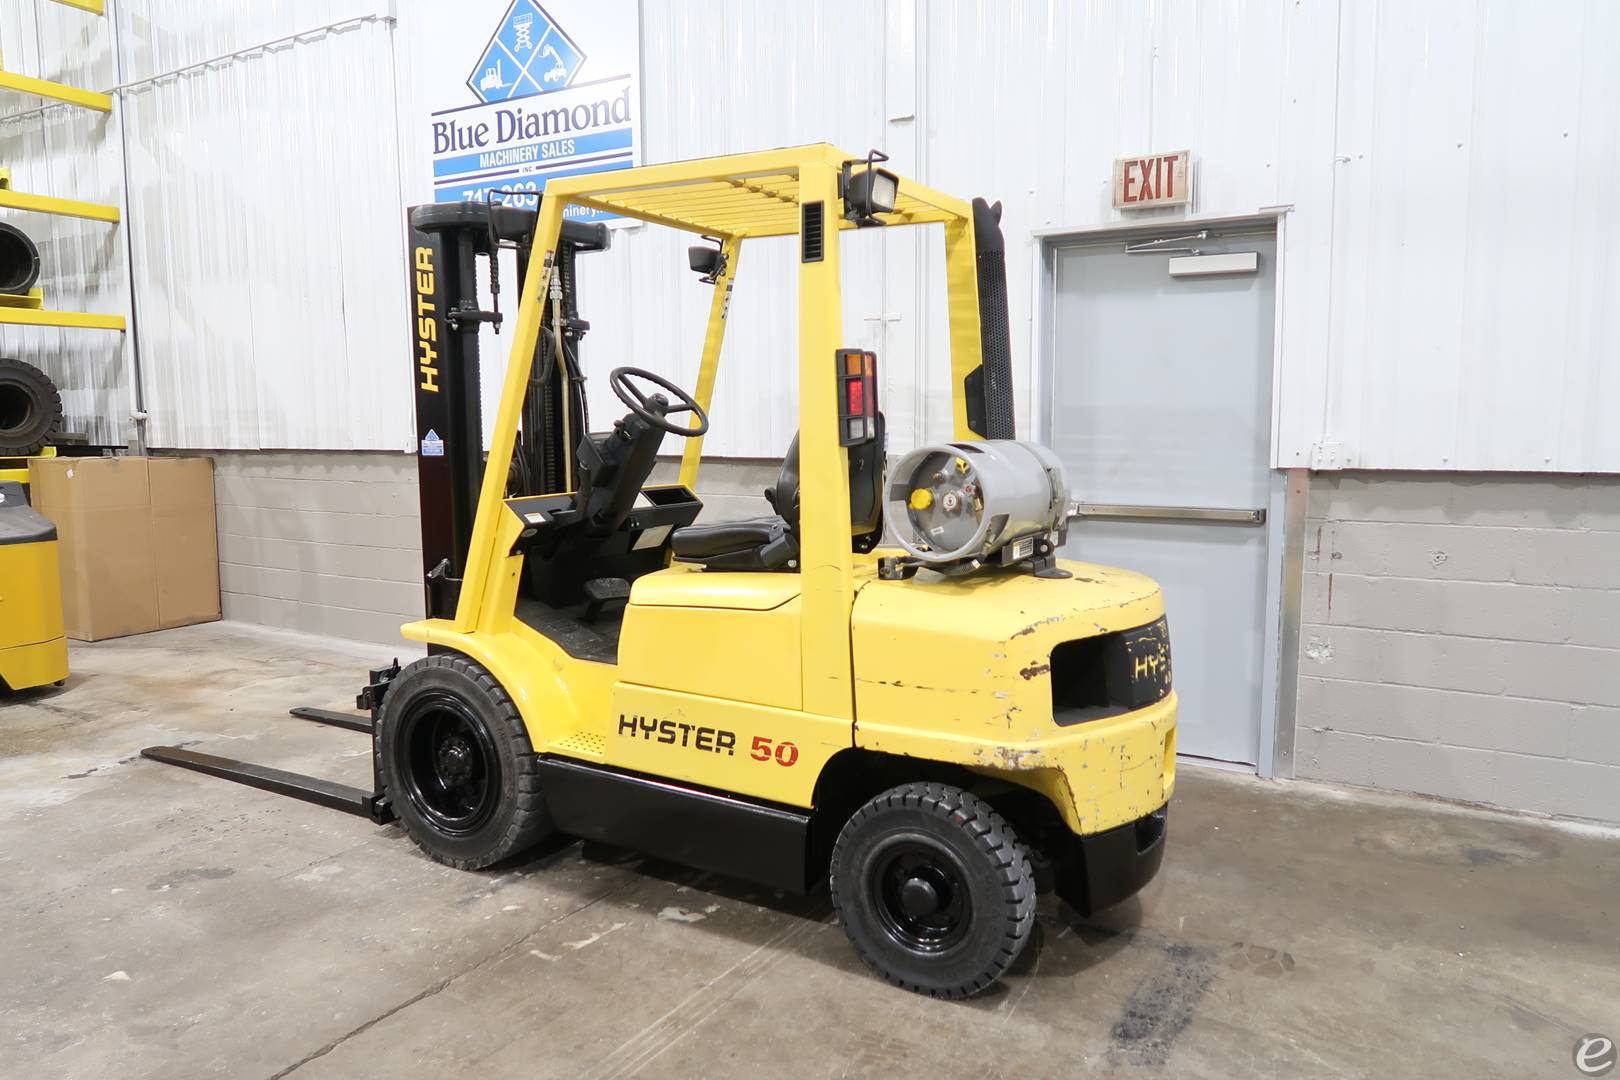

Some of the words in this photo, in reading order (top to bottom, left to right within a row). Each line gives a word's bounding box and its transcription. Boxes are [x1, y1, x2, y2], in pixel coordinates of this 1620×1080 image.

[432, 119, 489, 154] Blue
[495, 86, 631, 143] Diamond
[479, 144, 539, 168] MACHINERY
[541, 139, 575, 160] SALES
[1123, 155, 1179, 203] EXIT
[415, 246, 440, 393] HYSTER
[618, 714, 736, 756] HYSTER
[750, 735, 799, 767] 50
